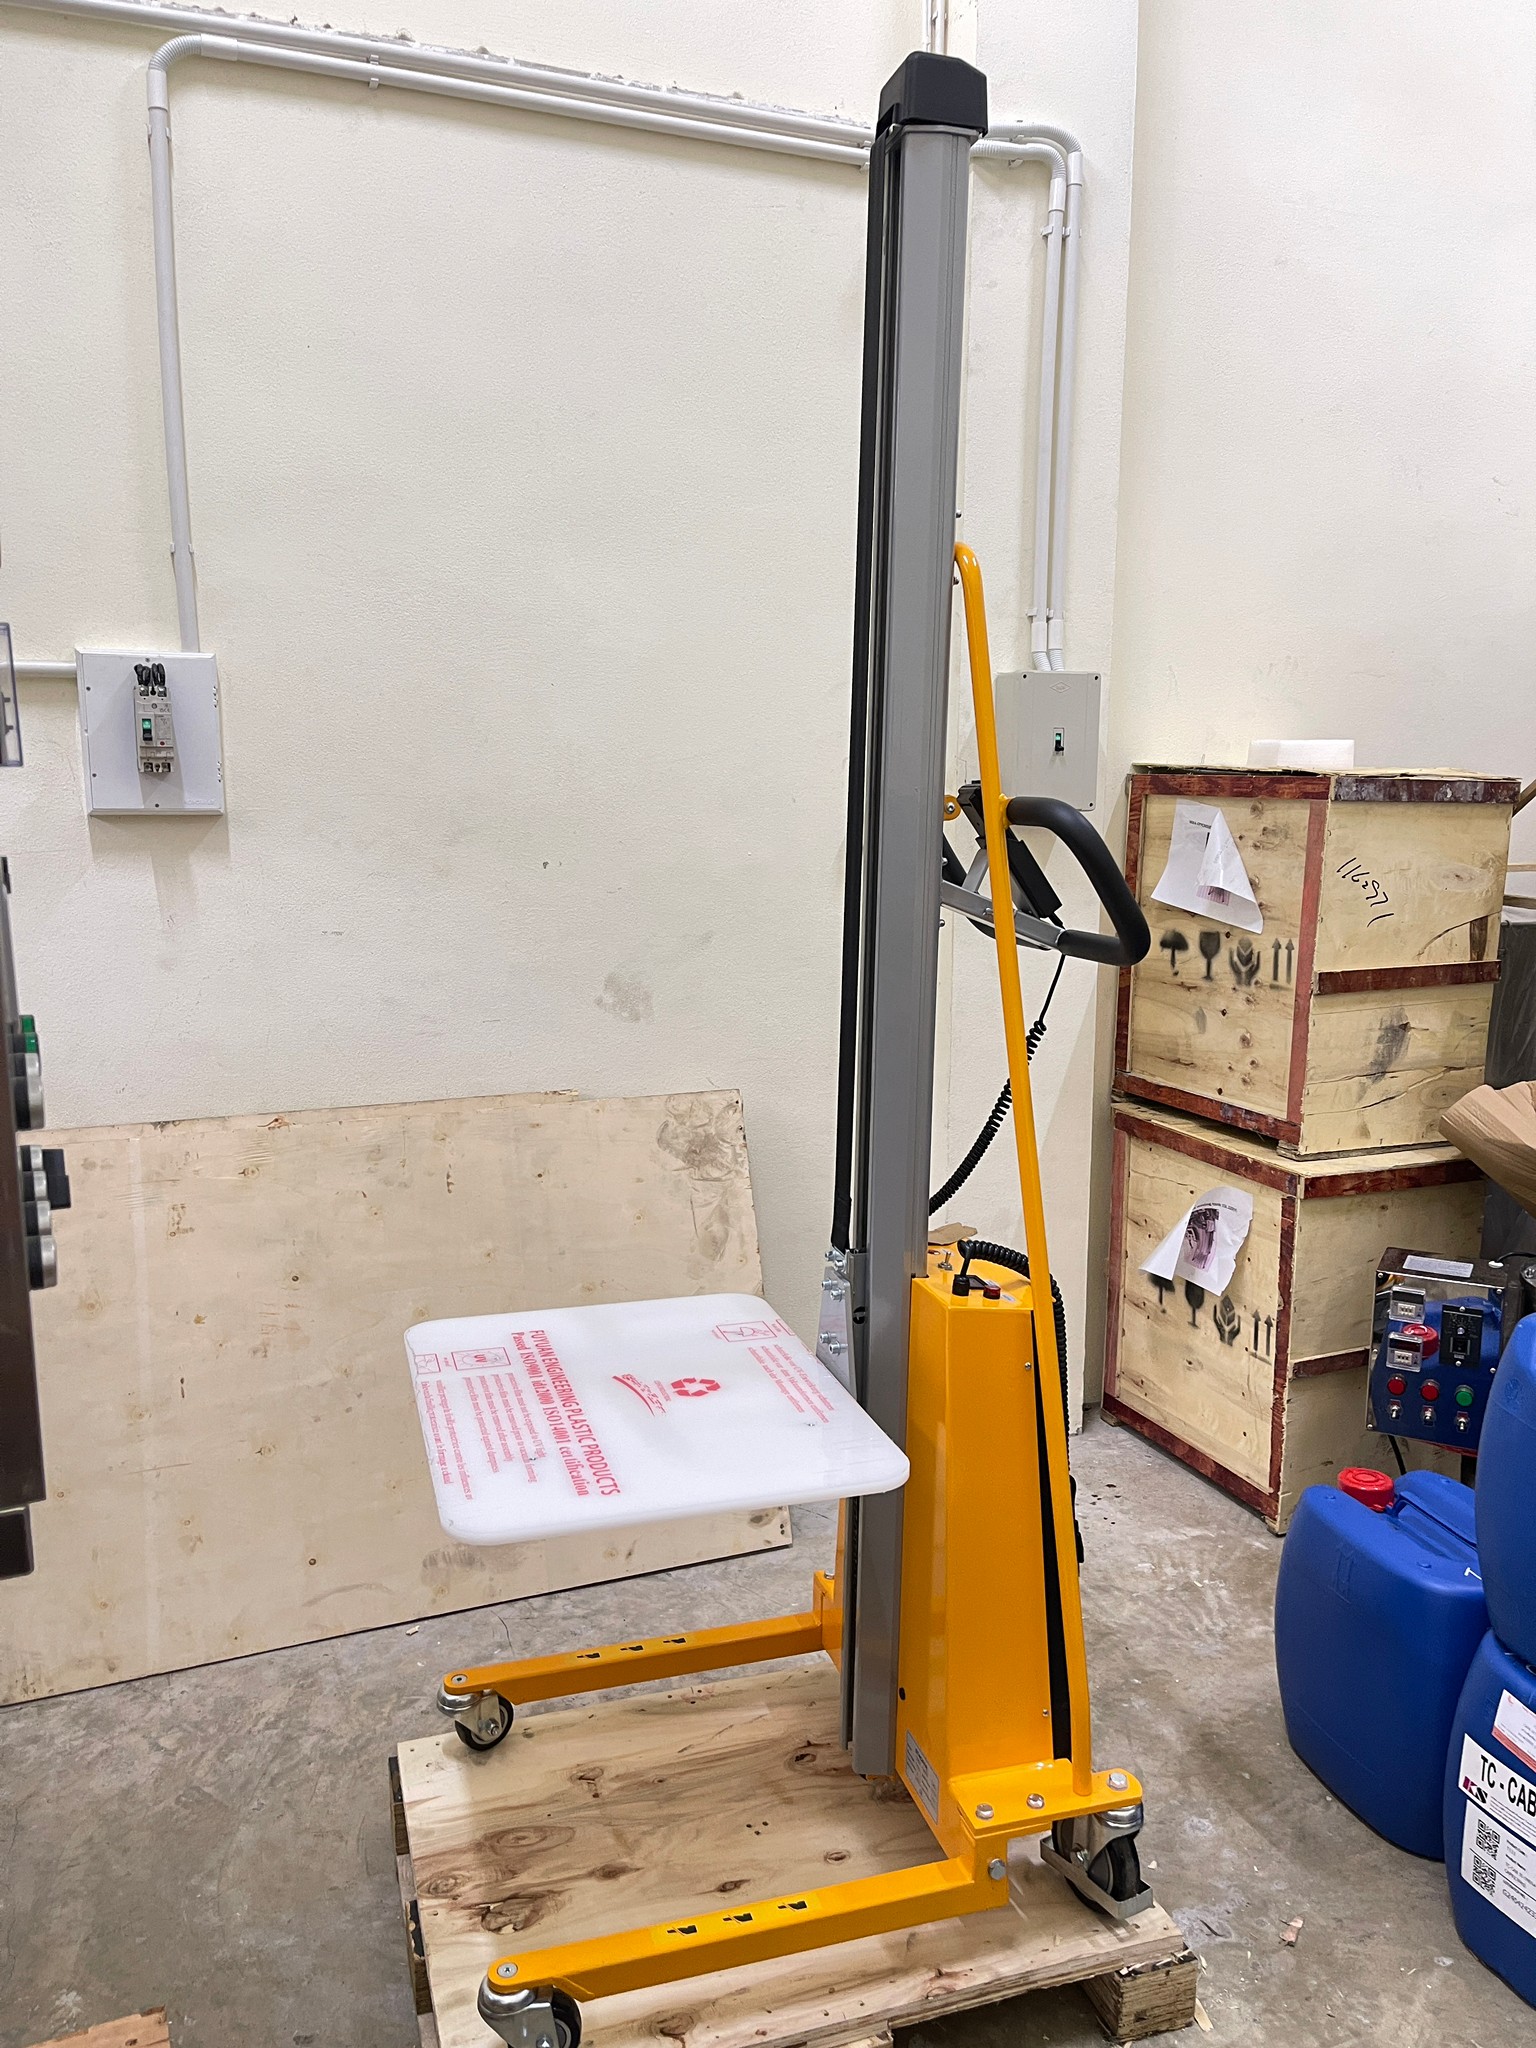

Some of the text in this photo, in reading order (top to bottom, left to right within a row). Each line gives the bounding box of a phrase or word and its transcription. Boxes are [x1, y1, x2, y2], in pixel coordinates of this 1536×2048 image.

[529, 1330, 621, 1496] FUYUAN ENGINEERING PLASTIC PRODUCTS
[543, 1406, 572, 1444] ISO14001
[559, 1445, 590, 1497] certification
[1463, 1776, 1488, 1804] KS
[1481, 1754, 1496, 1789] TC
